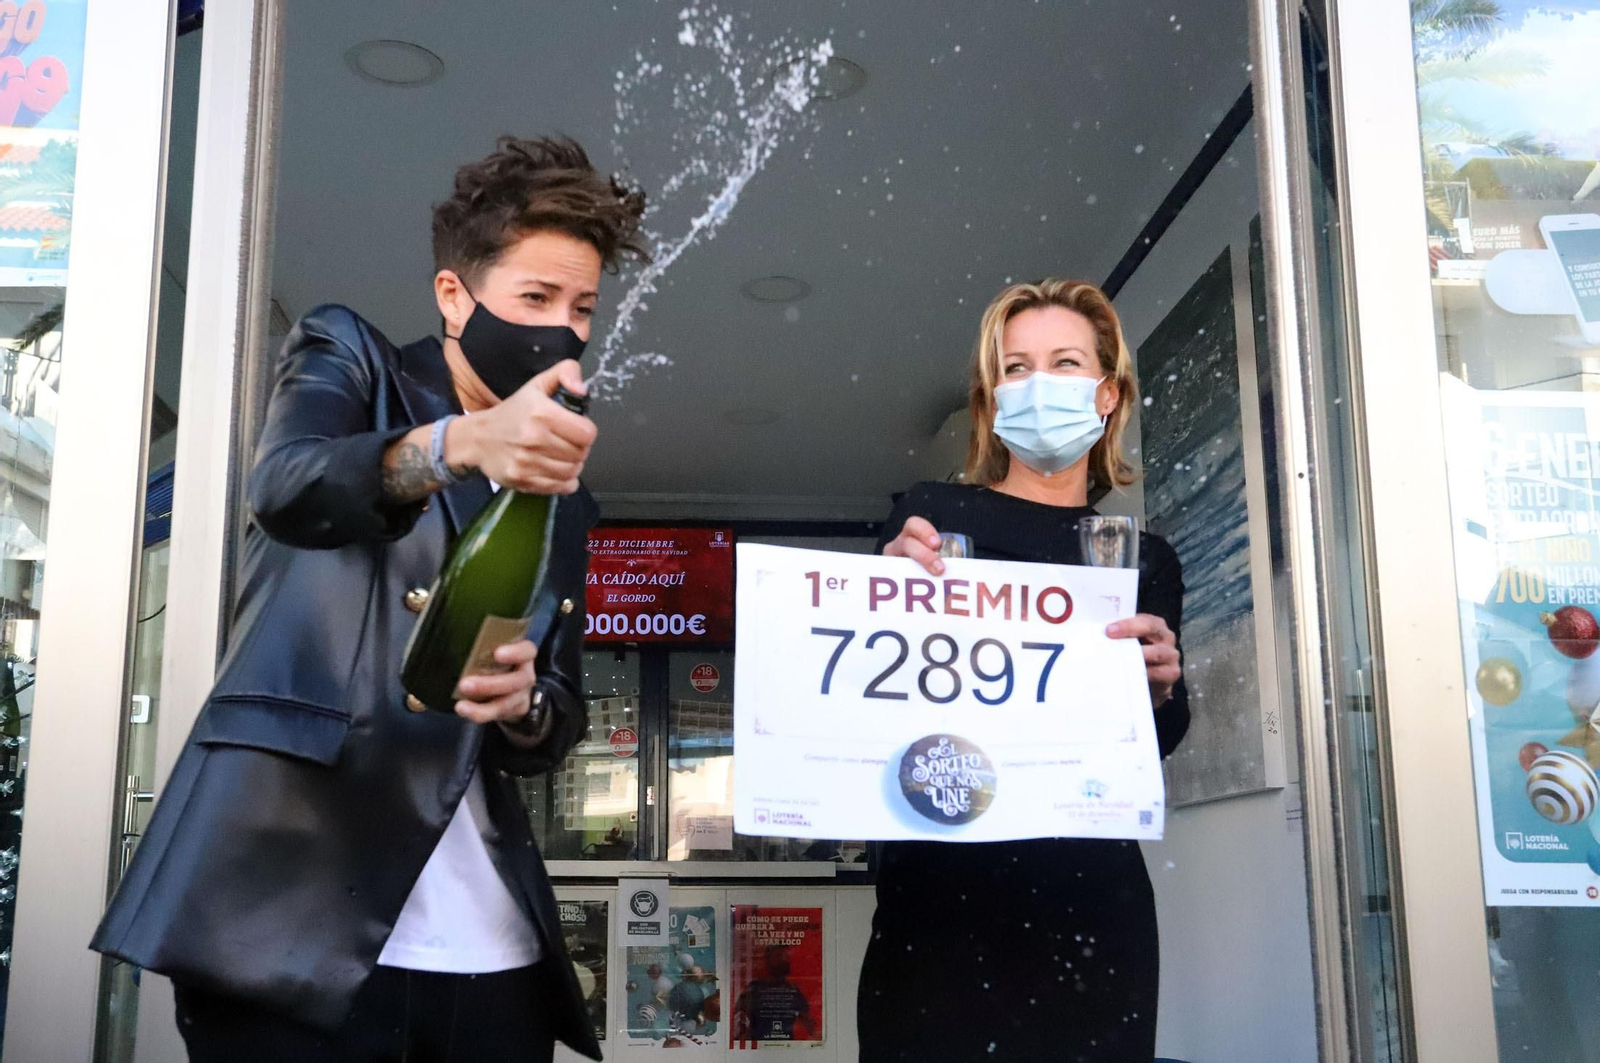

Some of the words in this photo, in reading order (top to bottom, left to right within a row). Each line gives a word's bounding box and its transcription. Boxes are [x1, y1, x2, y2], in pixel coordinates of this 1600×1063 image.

[1473, 227, 1497, 236] EURO
[1500, 224, 1521, 235] MÁS
[1495, 241, 1521, 249] JOKER
[1486, 482, 1559, 507] SORTEO
[588, 540, 599, 548] 22
[602, 540, 615, 548] DE
[618, 540, 675, 548] DICIEMBRE
[602, 571, 647, 585] CAÍDO
[648, 571, 686, 587] AQUÍ
[1496, 567, 1544, 604] 700
[607, 594, 619, 602] EL
[621, 594, 656, 603] GORDO
[868, 576, 1074, 624] PREMIO
[1548, 588, 1565, 604] EN
[696, 666, 713, 676] +18
[811, 627, 1065, 705] 72897
[615, 731, 631, 741] +18
[912, 753, 981, 782] SORTEO
[929, 775, 954, 789] QUE
[956, 772, 982, 790] NOS
[772, 819, 813, 827] NACIONAL
[1525, 834, 1560, 843] LOTERÍA
